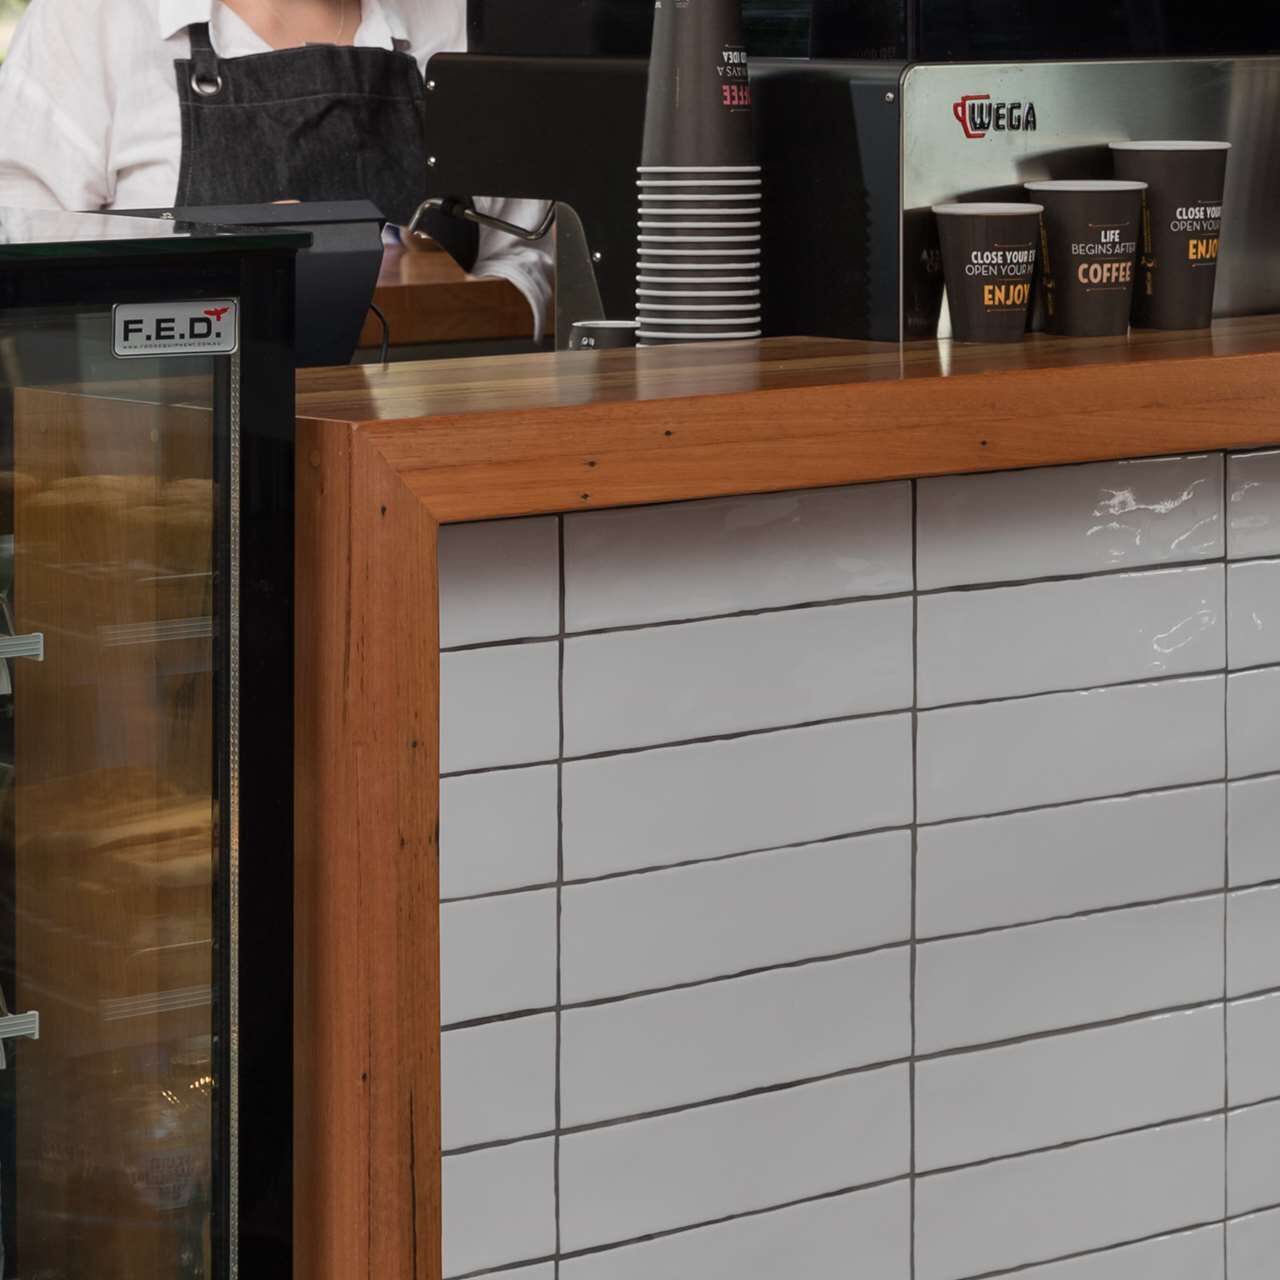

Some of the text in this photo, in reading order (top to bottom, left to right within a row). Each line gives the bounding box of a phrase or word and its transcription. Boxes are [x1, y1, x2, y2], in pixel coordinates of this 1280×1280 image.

[969, 101, 1037, 131] WEGA
[1176, 206, 1205, 220] CLOSE
[1170, 220, 1200, 231] OPEN
[1101, 229, 1120, 243] LIFE
[1071, 243, 1113, 255] BEGINS
[1188, 238, 1217, 260] ENJO
[971, 250, 1004, 264] CLOSE
[1005, 250, 1028, 263] YOUR
[965, 264, 998, 276] OPEN
[1000, 264, 1026, 276] YOUR
[1078, 261, 1132, 284] COFFEE
[983, 284, 1030, 306] ENJOY
[123, 317, 222, 342] F.E.D.
